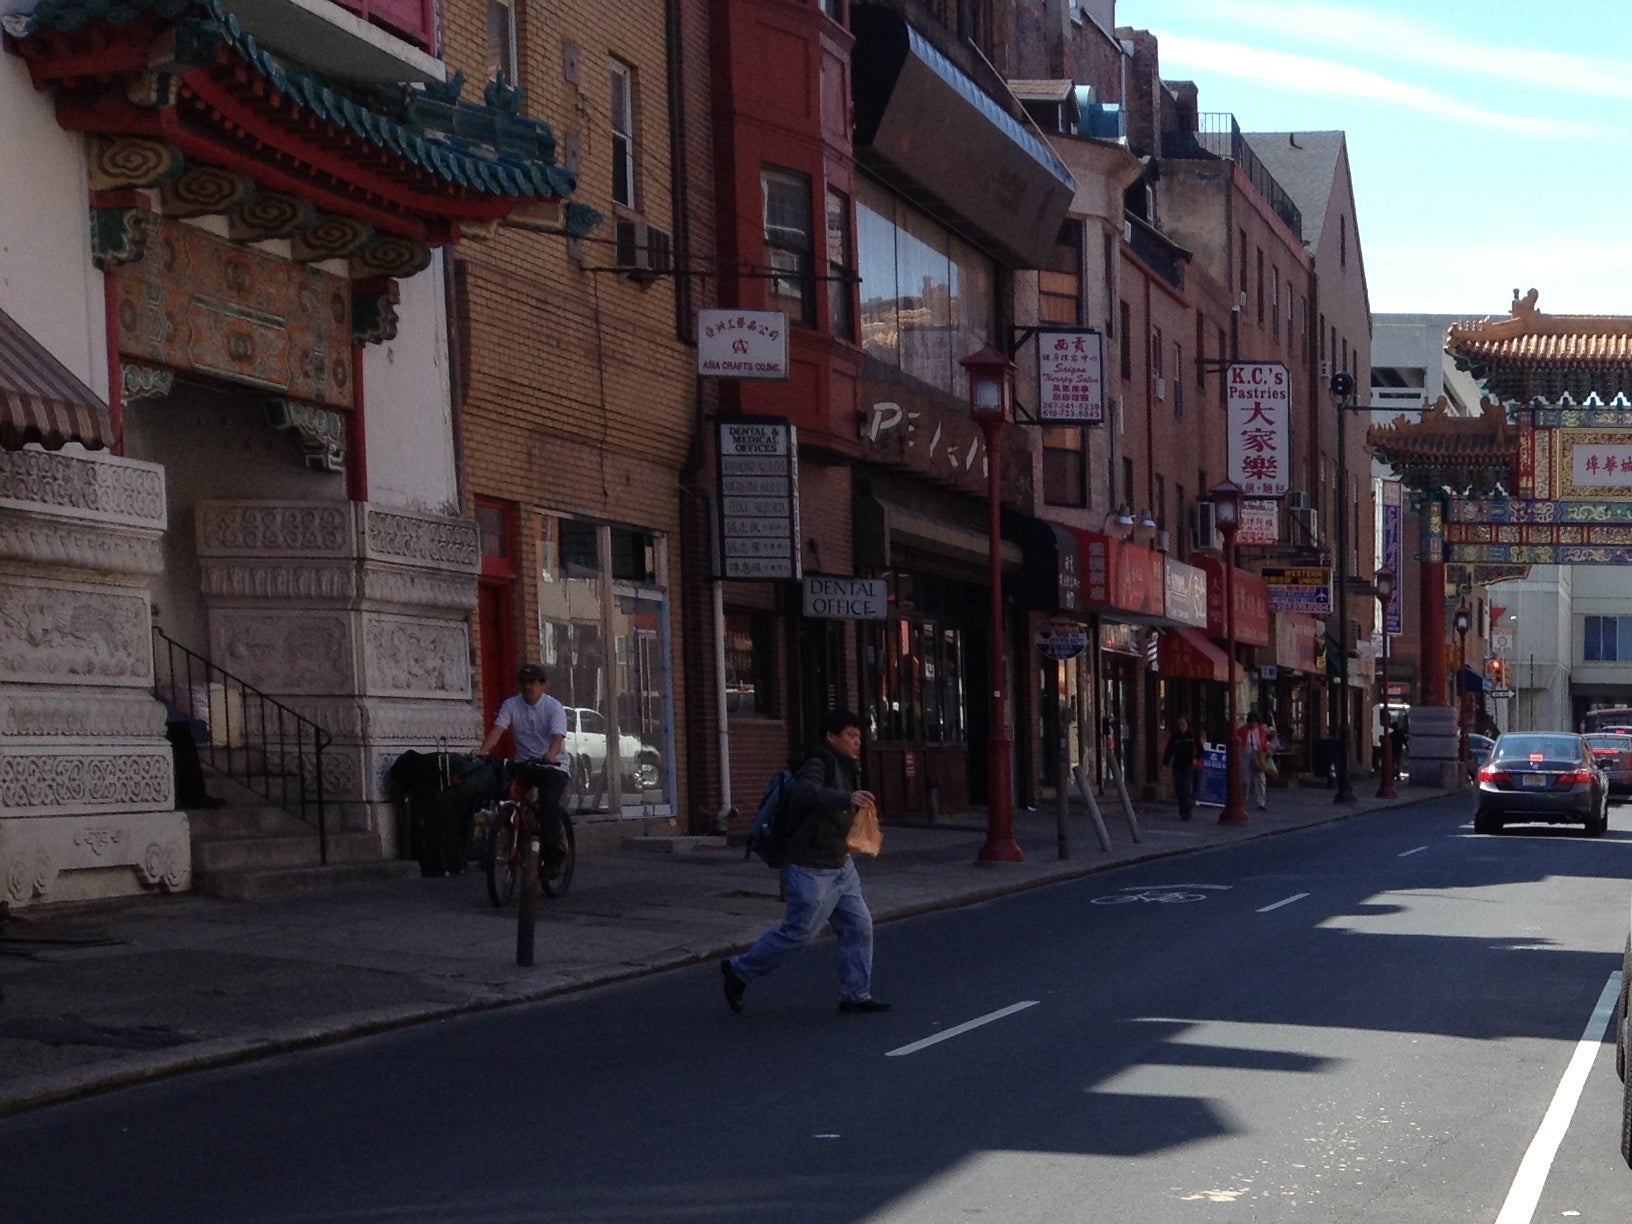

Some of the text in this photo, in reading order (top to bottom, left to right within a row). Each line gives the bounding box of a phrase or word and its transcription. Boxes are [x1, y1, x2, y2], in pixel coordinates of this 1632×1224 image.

[703, 361, 720, 370] ASIA
[722, 361, 753, 371] CRAFTS
[1231, 366, 1284, 385] K.C.'s
[1229, 386, 1287, 400] Pastries
[729, 427, 779, 436] DENTAL &
[732, 435, 779, 444] MEDICAL
[1240, 401, 1278, 480] 大家樂
[735, 444, 777, 453] OFFICES
[809, 580, 877, 598] DENTAL
[812, 598, 876, 616] OFFICE
